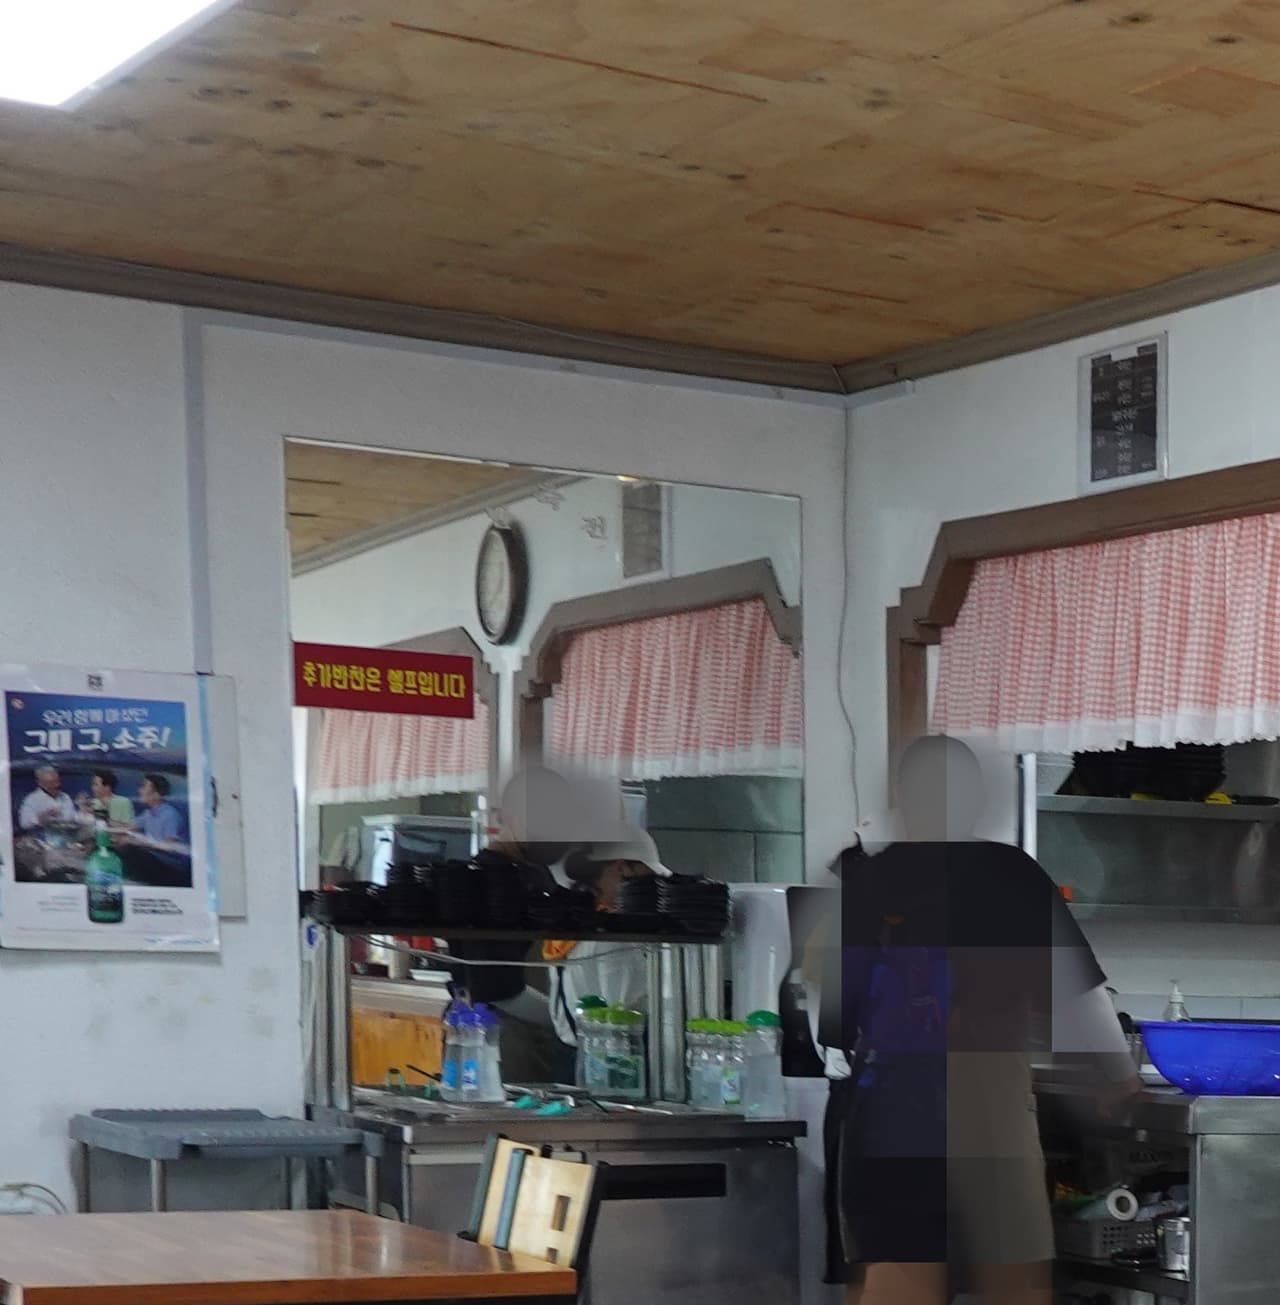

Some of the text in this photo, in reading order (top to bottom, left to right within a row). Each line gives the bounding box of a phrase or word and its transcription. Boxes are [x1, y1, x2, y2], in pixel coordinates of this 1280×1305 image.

[303, 661, 465, 699] 추가반찬은 셀프입니다
[77, 728, 109, 752] 그,
[112, 726, 171, 750] 소주!
